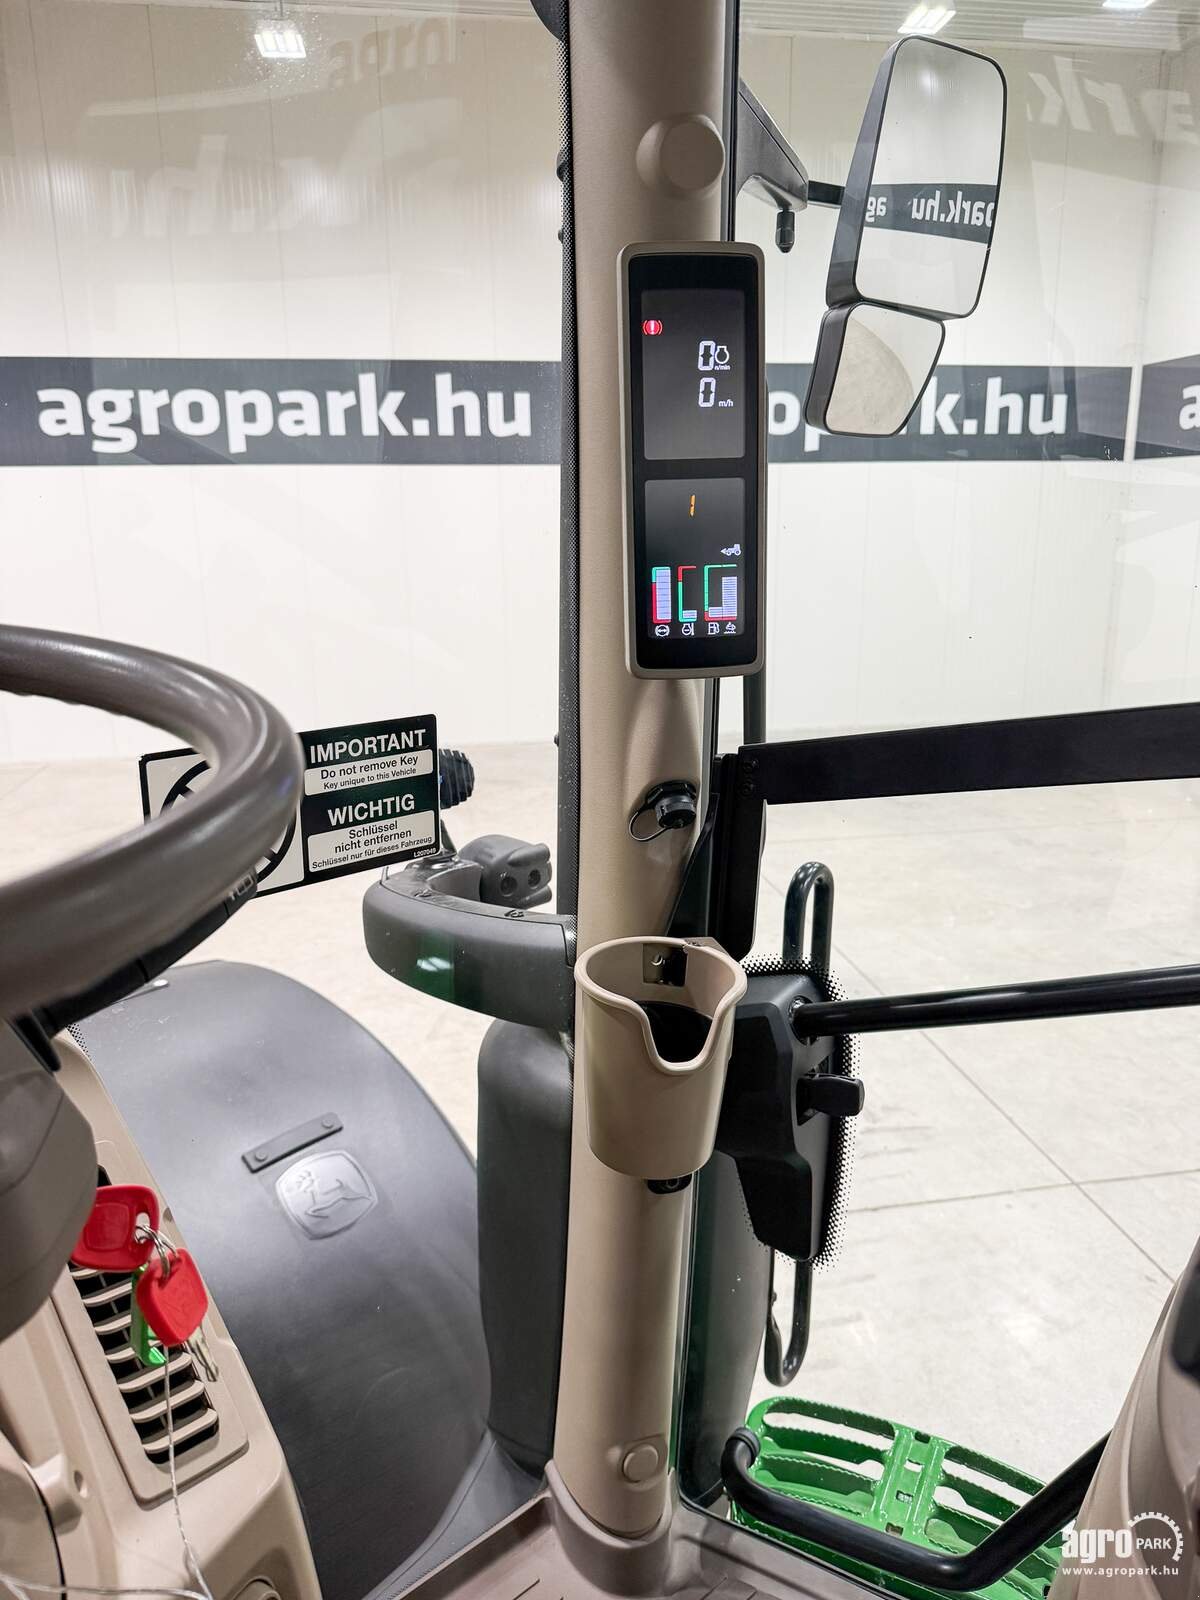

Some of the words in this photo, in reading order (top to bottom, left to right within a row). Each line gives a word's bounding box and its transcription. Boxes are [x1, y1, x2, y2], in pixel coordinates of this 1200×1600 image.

[698, 340, 716, 371] 0
[698, 377, 717, 408] 0
[718, 398, 734, 407] m/h
[36, 372, 533, 455] agropark.hu
[310, 729, 426, 764] IMPORTANT
[320, 769, 336, 780] Do
[339, 764, 357, 777] not
[359, 759, 398, 774] remove
[400, 755, 419, 766] Key
[323, 782, 339, 791] Key
[340, 776, 366, 788] unique
[367, 774, 375, 782] to
[376, 771, 390, 780] this
[391, 767, 417, 778] Vehicle
[328, 793, 415, 827] WICHTIG
[335, 839, 361, 854] nicht
[364, 829, 412, 847] entfernen
[349, 820, 398, 840] Schlüssel
[312, 854, 349, 869] Schlüssel
[350, 852, 363, 861] nur
[364, 849, 376, 858] für
[376, 843, 400, 855] dieses
[400, 836, 433, 849] Fahrzeug
